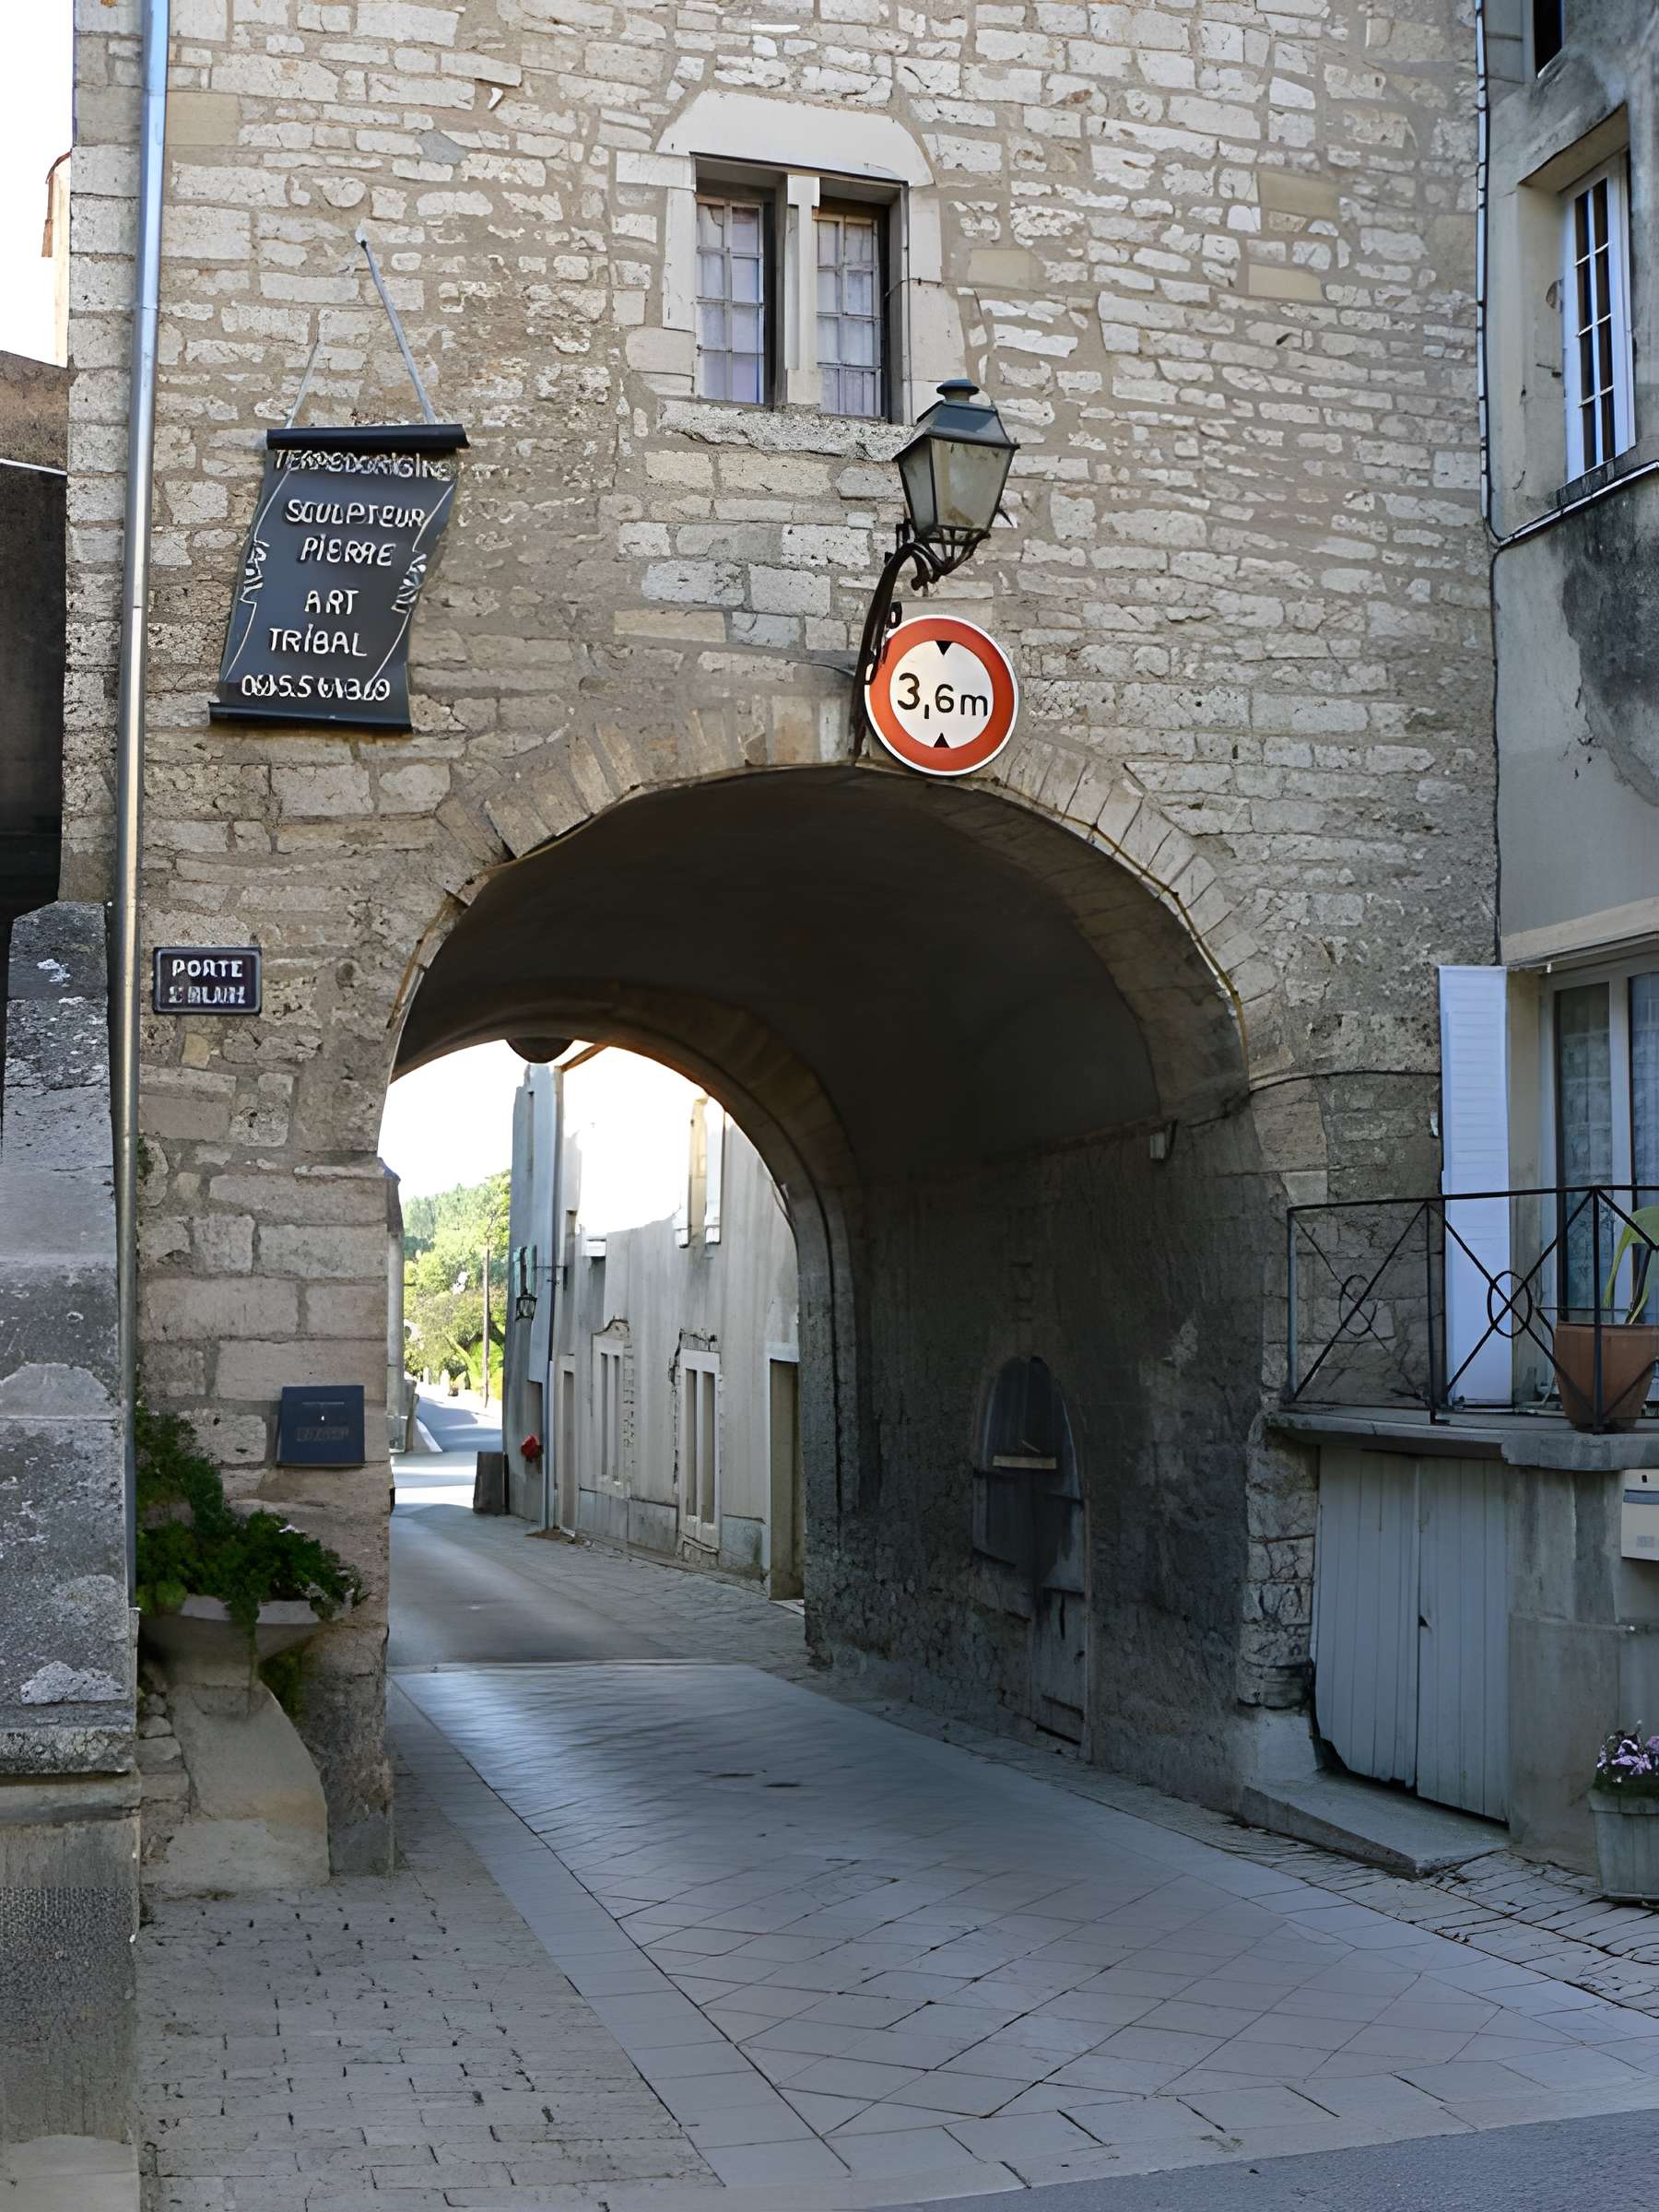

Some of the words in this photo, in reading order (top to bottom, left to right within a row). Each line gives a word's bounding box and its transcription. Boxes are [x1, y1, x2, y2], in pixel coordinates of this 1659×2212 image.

[286, 499, 426, 527] SCULPTEUR
[300, 533, 396, 566] PIERRE
[304, 590, 360, 615] ART
[269, 623, 368, 656] TRIBAL
[171, 959, 243, 978] PORTE
